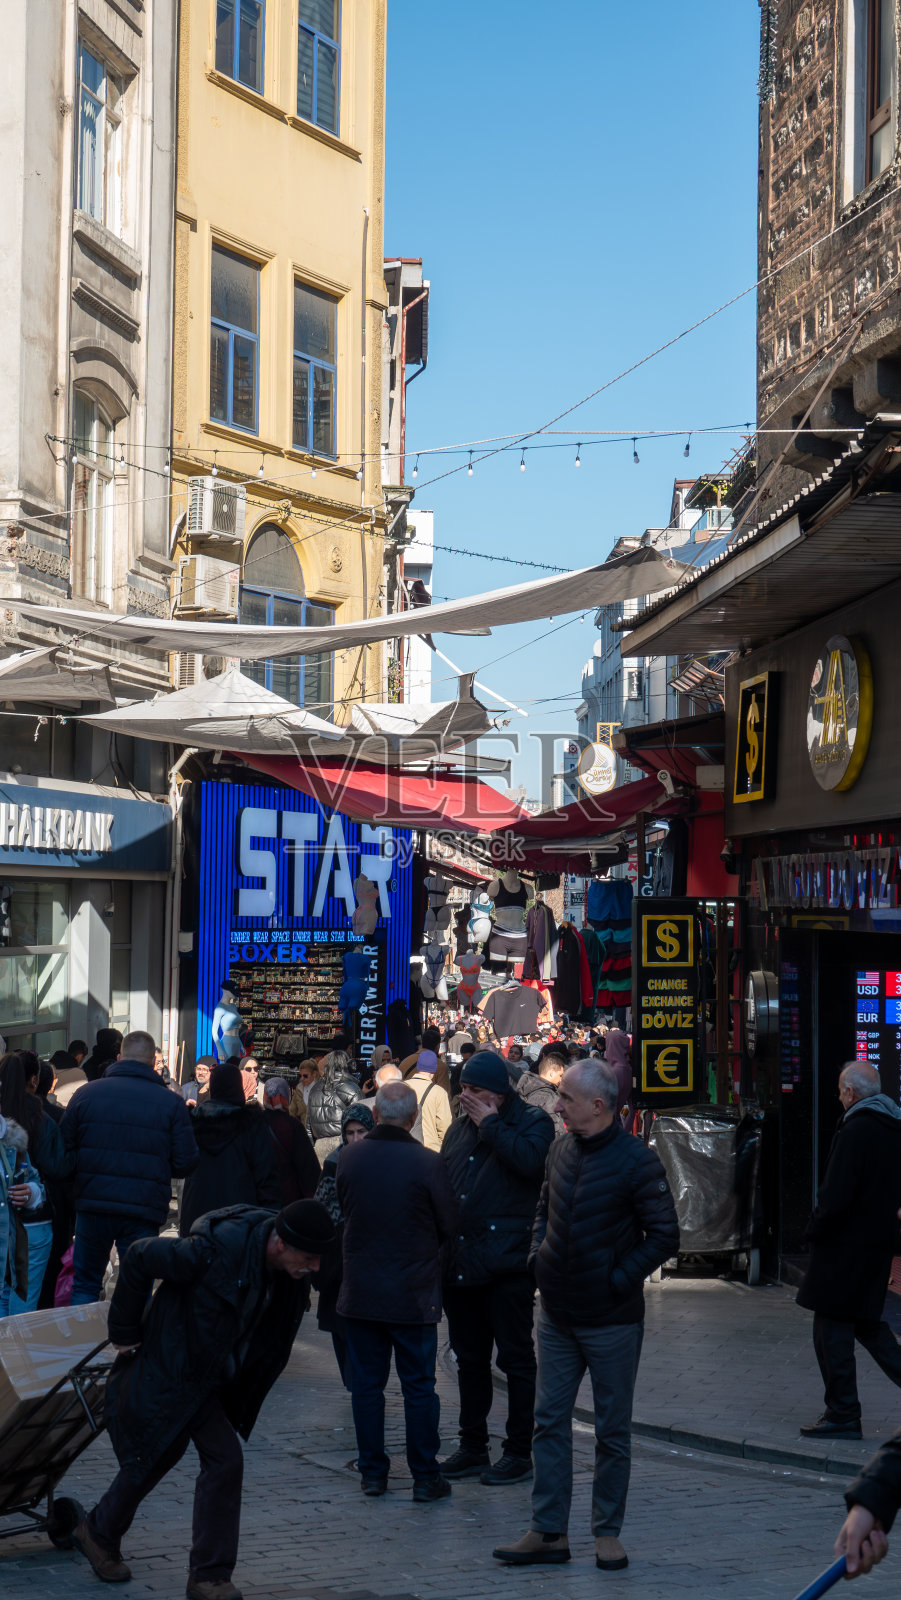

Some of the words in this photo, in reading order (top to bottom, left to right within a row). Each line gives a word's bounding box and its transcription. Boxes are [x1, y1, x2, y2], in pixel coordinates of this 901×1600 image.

[0, 802, 115, 852] HALKBANK
[238, 807, 393, 918] STAR
[230, 931, 251, 943] UNDER
[253, 931, 269, 943] WEAR
[271, 931, 290, 942] SPACE
[292, 931, 311, 942] UNDER
[313, 931, 328, 942] WEAR
[330, 931, 345, 942] STAR
[229, 944, 309, 963] BOXER
[647, 978, 688, 991] CHANGE
[857, 985, 879, 995] USD
[641, 995, 694, 1008] EXCHANGE
[641, 1010, 694, 1029] DÖVİZ
[857, 1013, 878, 1023] EUR
[868, 1052, 880, 1060] NOK
